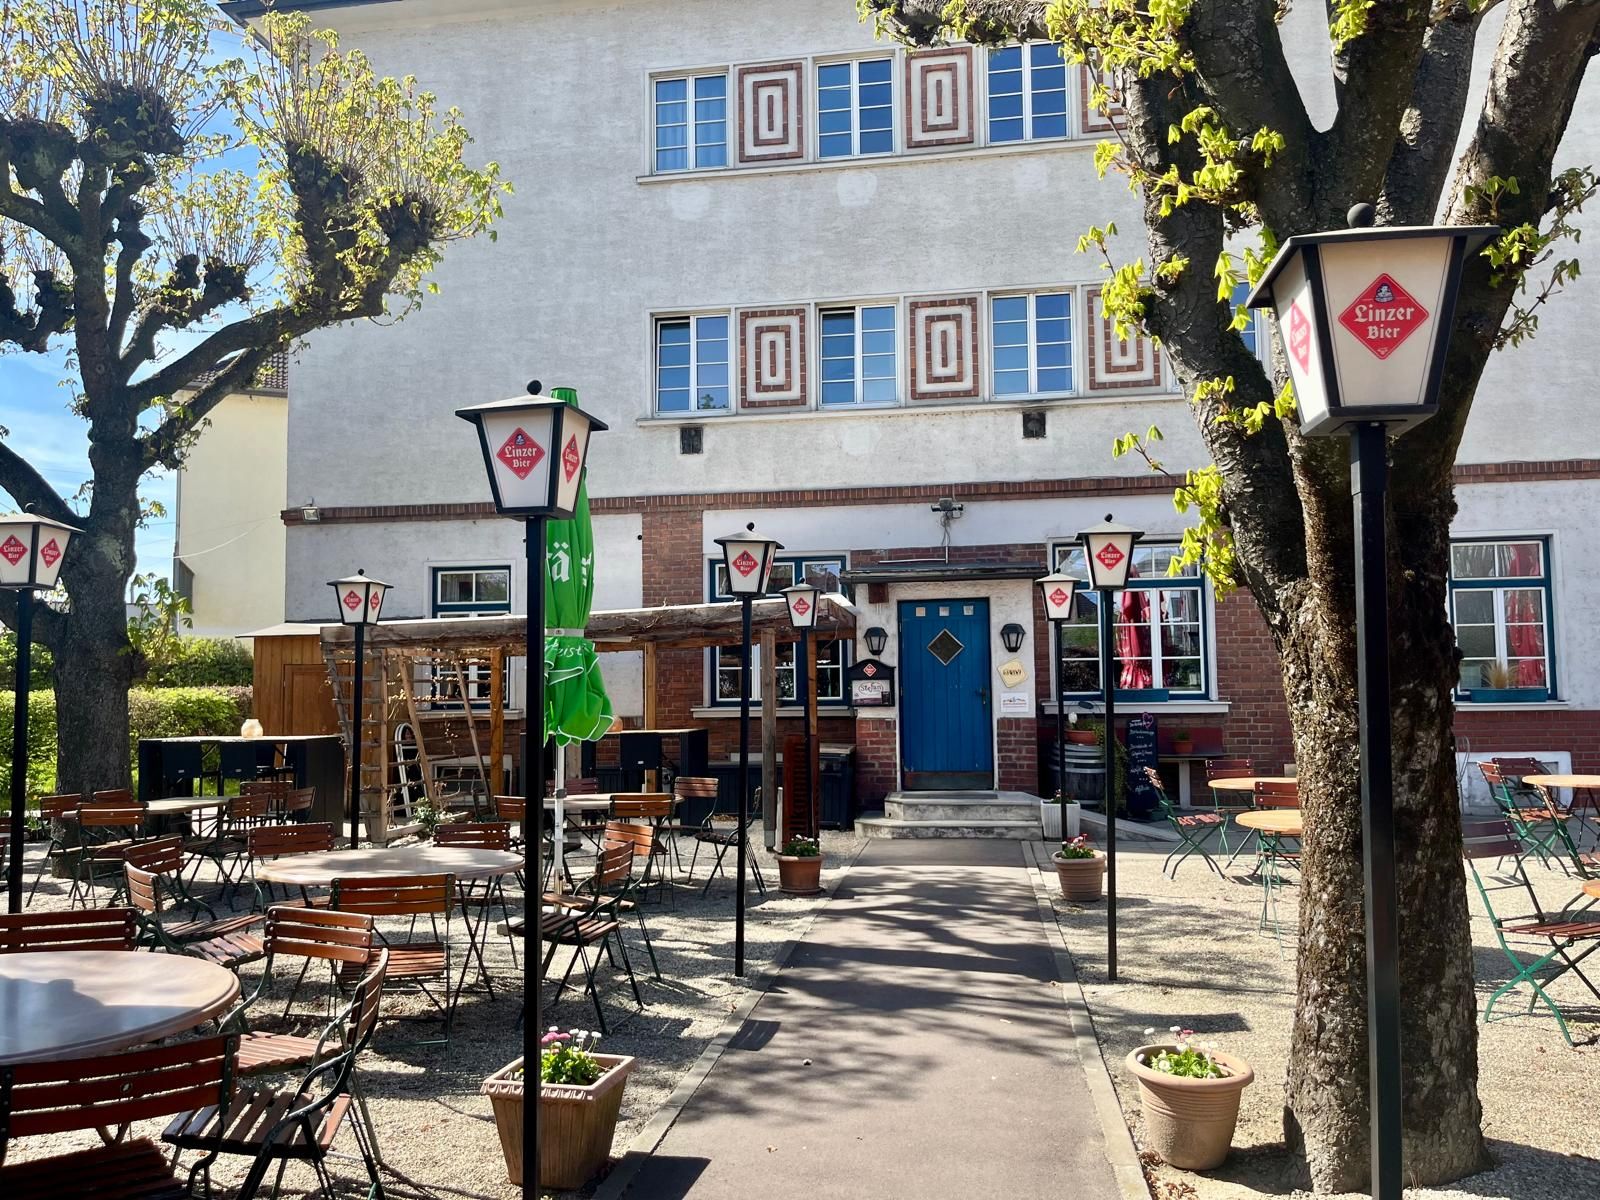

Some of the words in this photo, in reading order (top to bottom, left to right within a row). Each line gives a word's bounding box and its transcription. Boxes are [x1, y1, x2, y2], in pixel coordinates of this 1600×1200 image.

[1354, 304, 1415, 323] Linzer
[1366, 324, 1401, 340] Bier
[504, 445, 538, 458] Linzer
[512, 458, 531, 468] Bier
